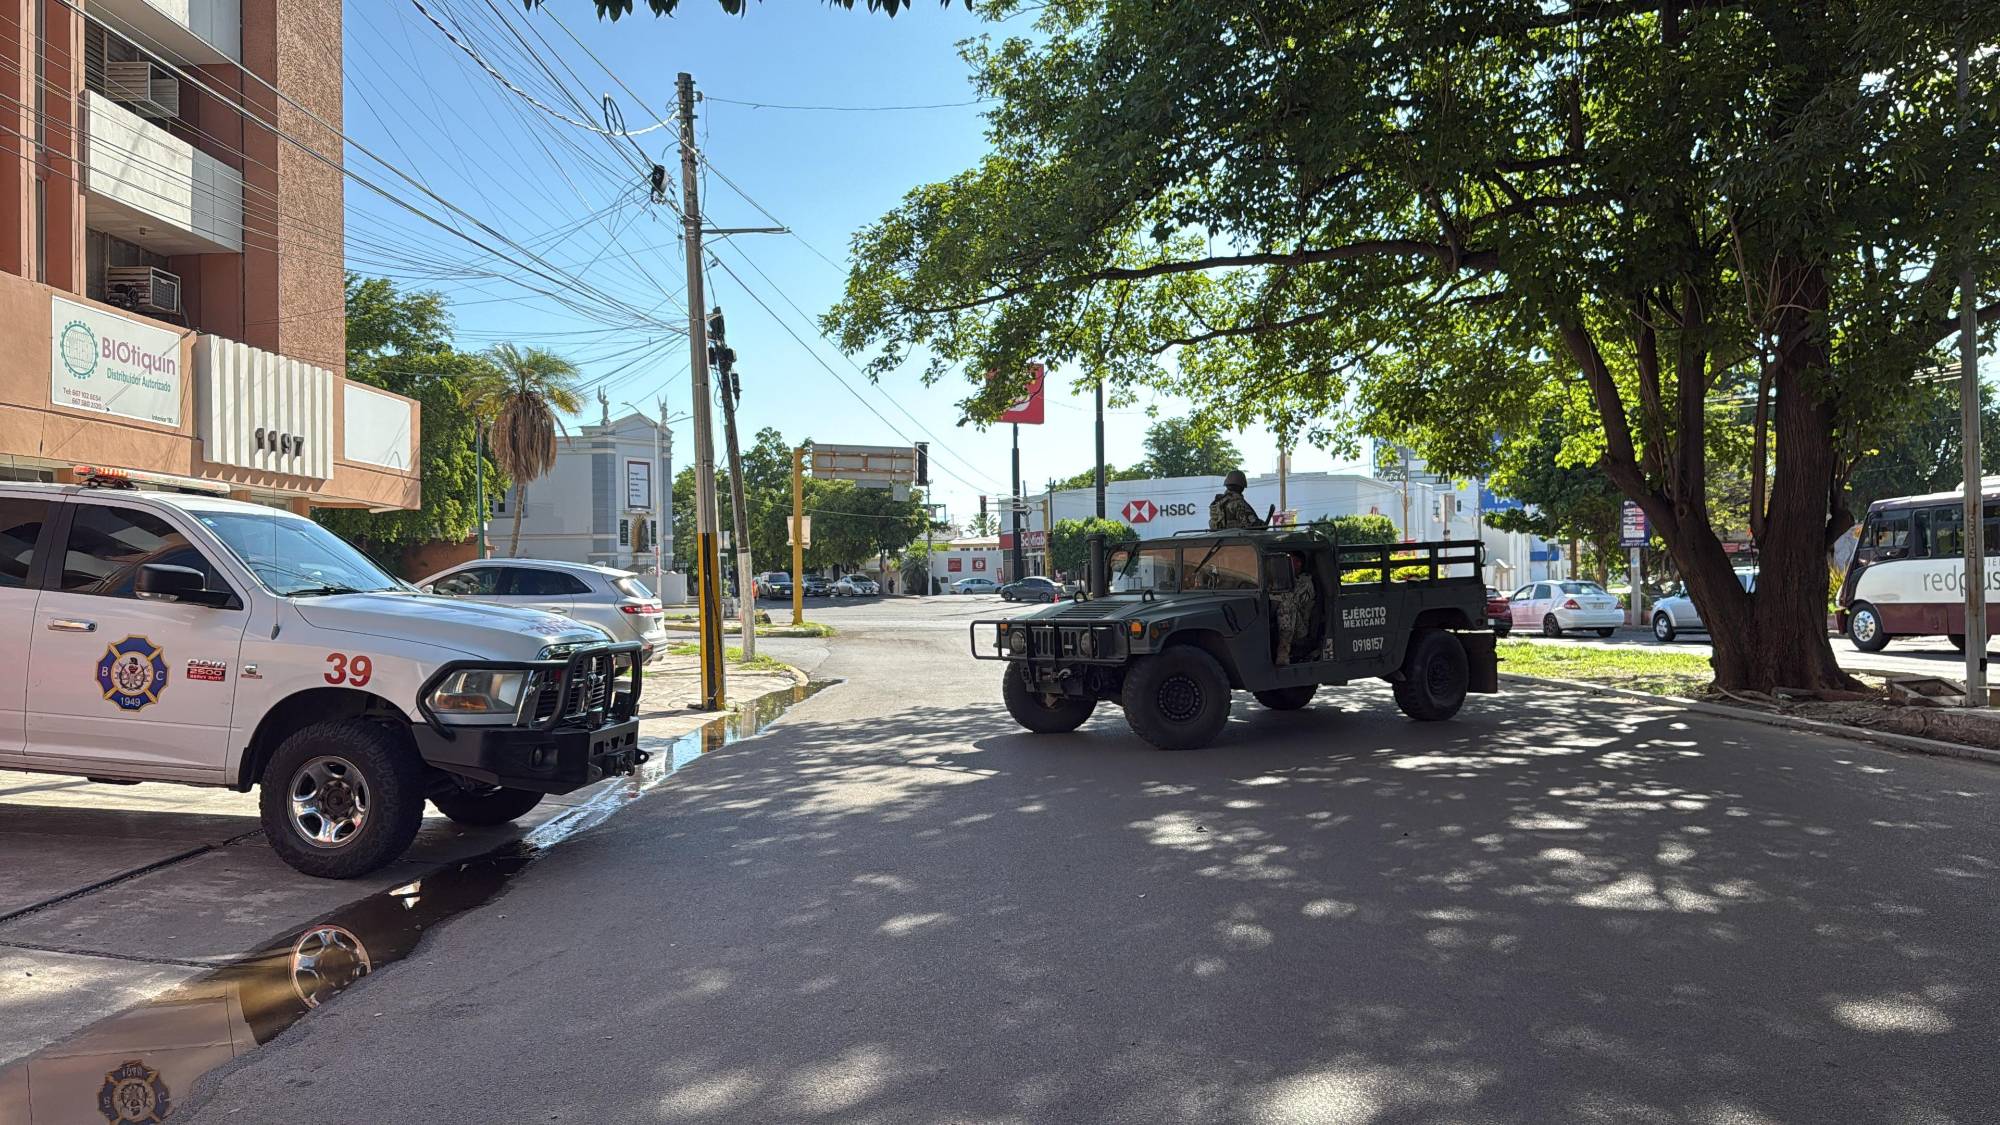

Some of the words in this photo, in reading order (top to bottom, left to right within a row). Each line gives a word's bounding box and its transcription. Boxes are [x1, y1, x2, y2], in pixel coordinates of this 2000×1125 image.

[106, 367, 141, 386] Distribuidor
[141, 376, 171, 393] Autorizado
[255, 427, 305, 457] 1197
[1159, 503, 1196, 517] HSBC
[1342, 606, 1387, 620] EJÉRCITO
[1343, 617, 1386, 628] MEXICANO
[1352, 637, 1384, 652] 0918157
[101, 666, 108, 677] B
[155, 671, 164, 681] C
[189, 668, 223, 676] 2500
[323, 652, 373, 687] 39
[120, 697, 141, 707] 1949
